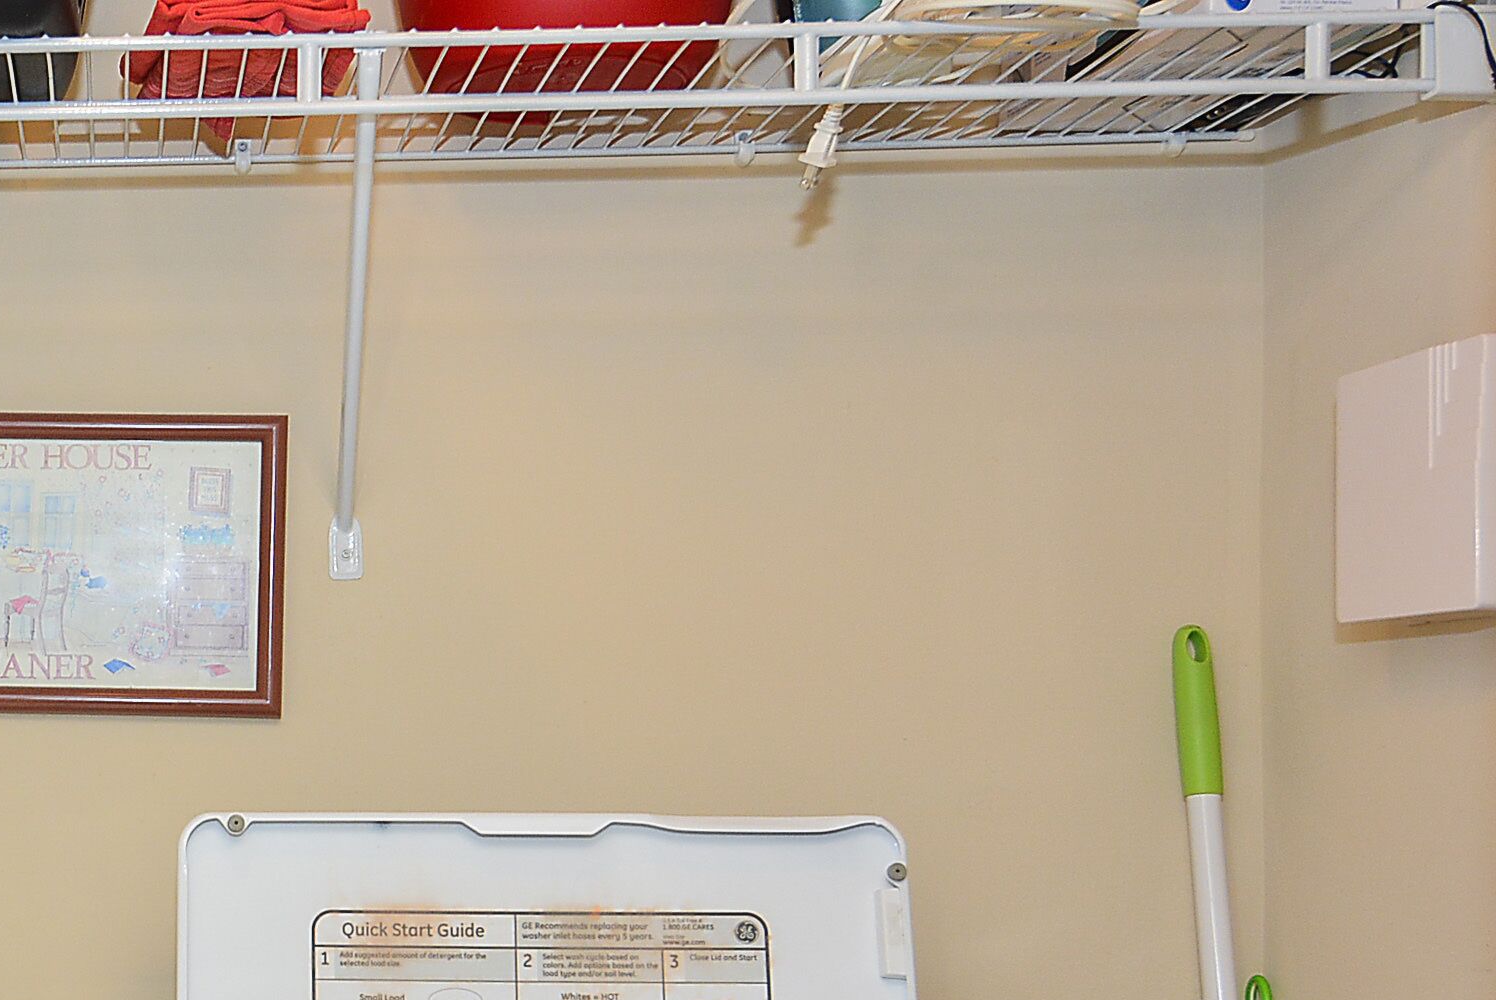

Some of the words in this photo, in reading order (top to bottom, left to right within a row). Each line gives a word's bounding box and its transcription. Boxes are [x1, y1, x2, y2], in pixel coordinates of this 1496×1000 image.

[42, 443, 152, 471] HOUSE
[342, 922, 388, 938] Quick
[392, 922, 433, 938] Start
[437, 922, 485, 938] Guide
[521, 922, 532, 930] GE
[590, 923, 628, 931] replacing
[629, 923, 648, 931] your
[572, 933, 596, 941] hoses
[321, 951, 330, 965] 1
[523, 953, 532, 968] 2
[670, 955, 679, 968] 3
[560, 993, 592, 1000] Whites
[601, 993, 619, 1000] HOT
